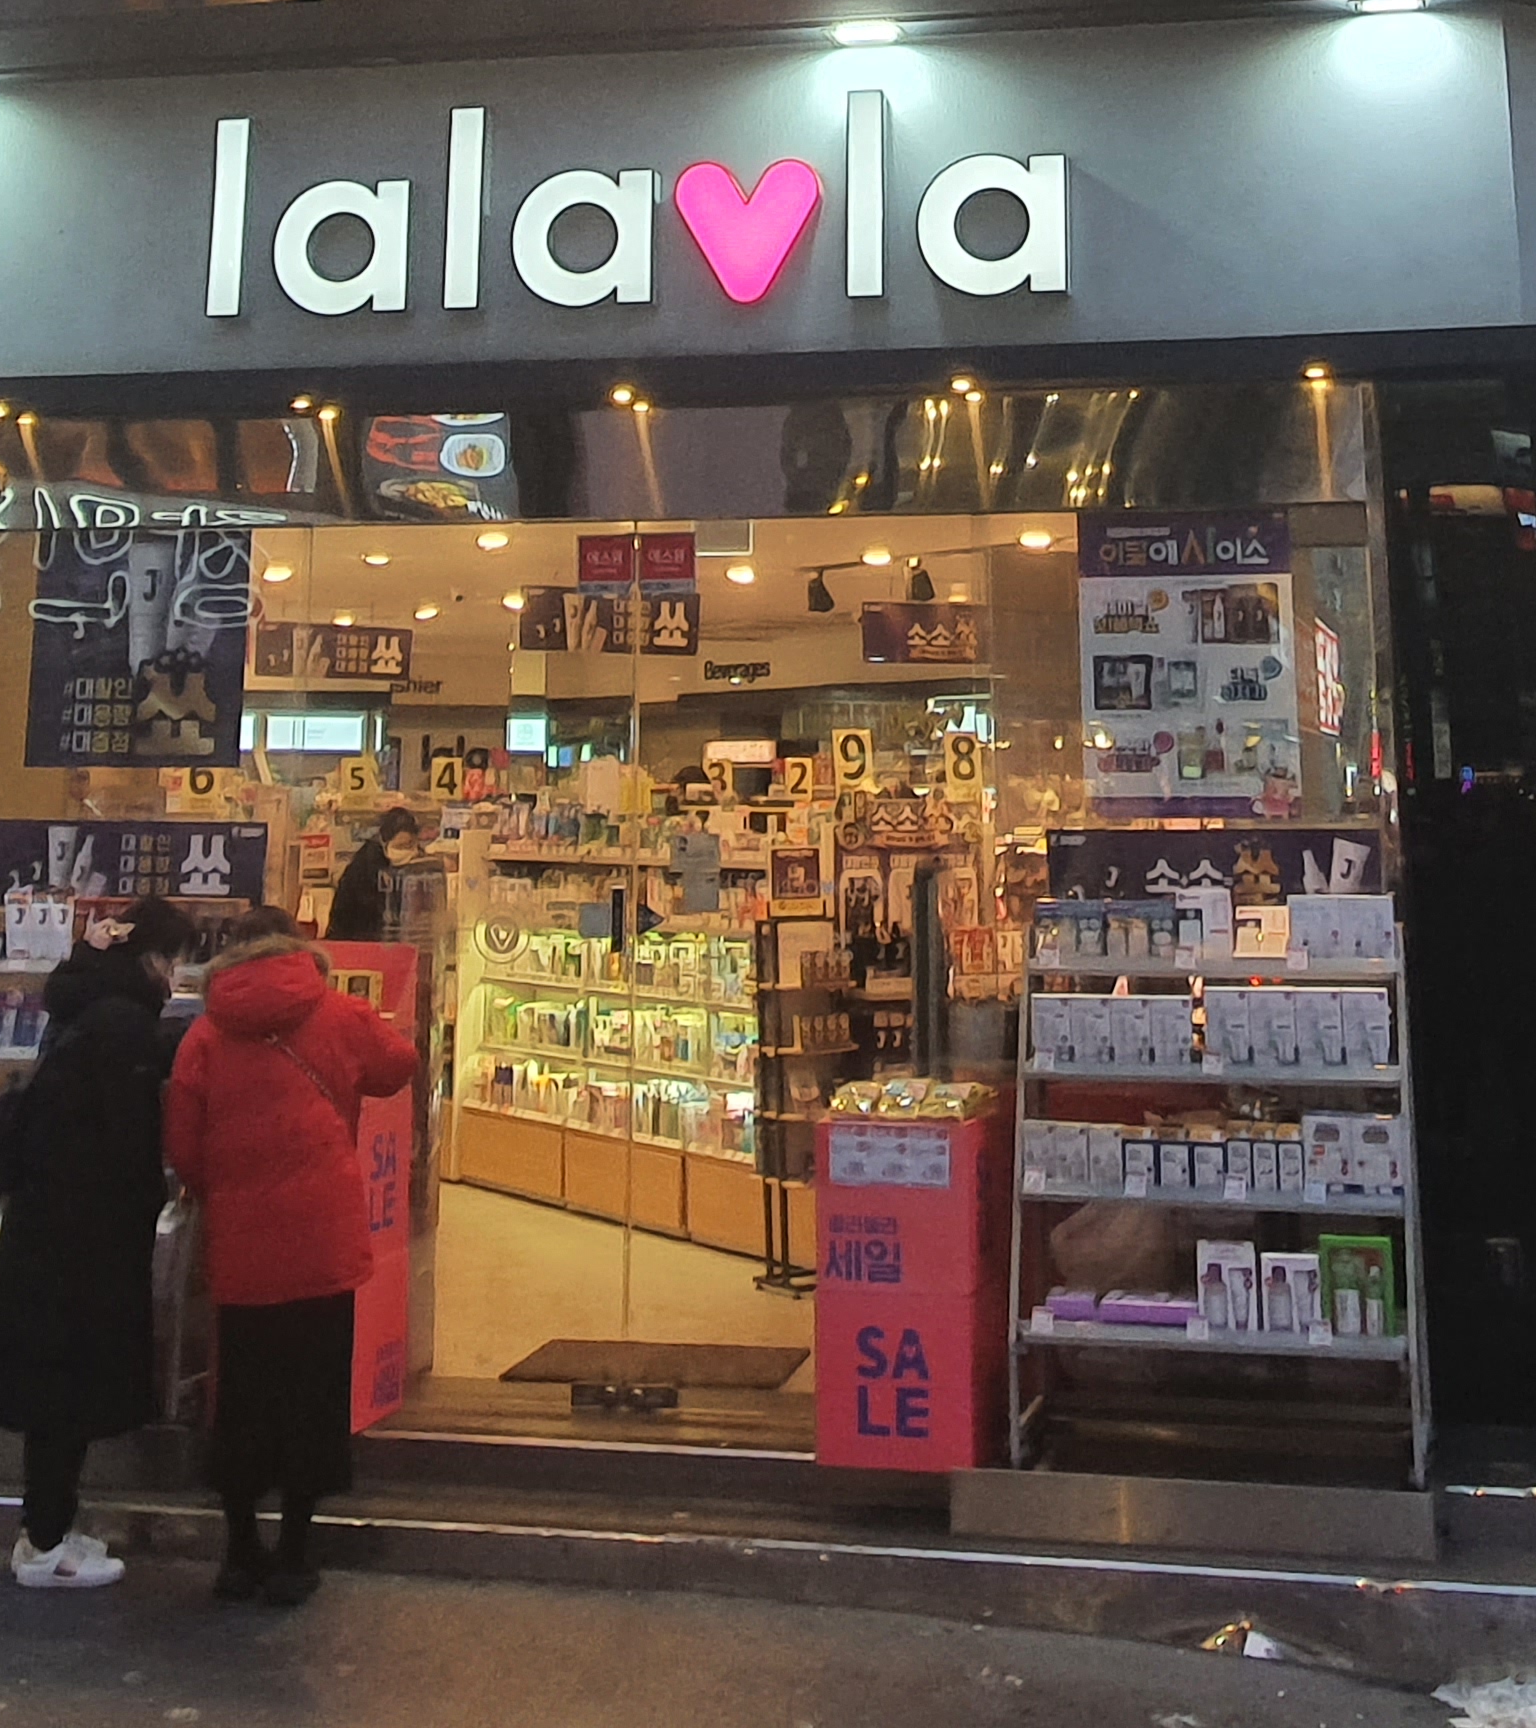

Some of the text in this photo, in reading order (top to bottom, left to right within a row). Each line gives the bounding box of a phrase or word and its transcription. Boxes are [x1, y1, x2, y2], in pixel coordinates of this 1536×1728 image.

[704, 660, 771, 683] Beverages
[350, 766, 365, 791] 5
[789, 762, 809, 795] 2
[840, 734, 866, 780] 9
[951, 736, 976, 780] 8
[436, 762, 458, 796] 4
[825, 1240, 901, 1283] 세일
[856, 1325, 930, 1380] SA
[857, 1385, 930, 1439] LE
